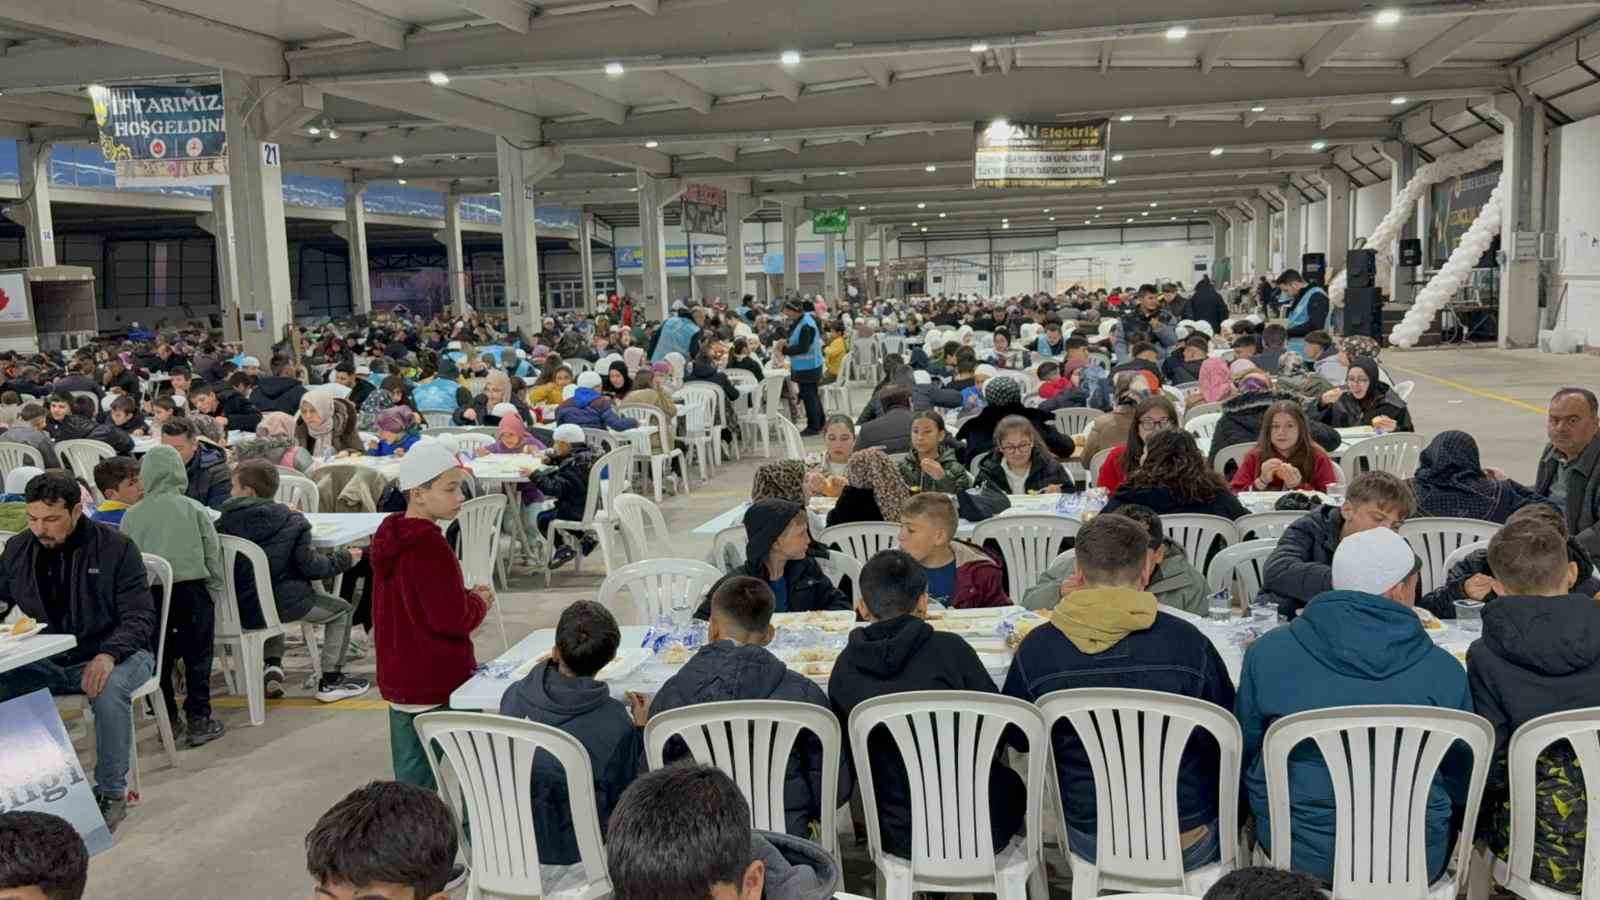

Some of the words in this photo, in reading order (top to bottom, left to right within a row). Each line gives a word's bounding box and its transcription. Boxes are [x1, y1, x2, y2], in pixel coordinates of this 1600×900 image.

[1040, 126, 1099, 139] Elektrik
[264, 144, 278, 165] 21
[0, 758, 84, 813] ngi
